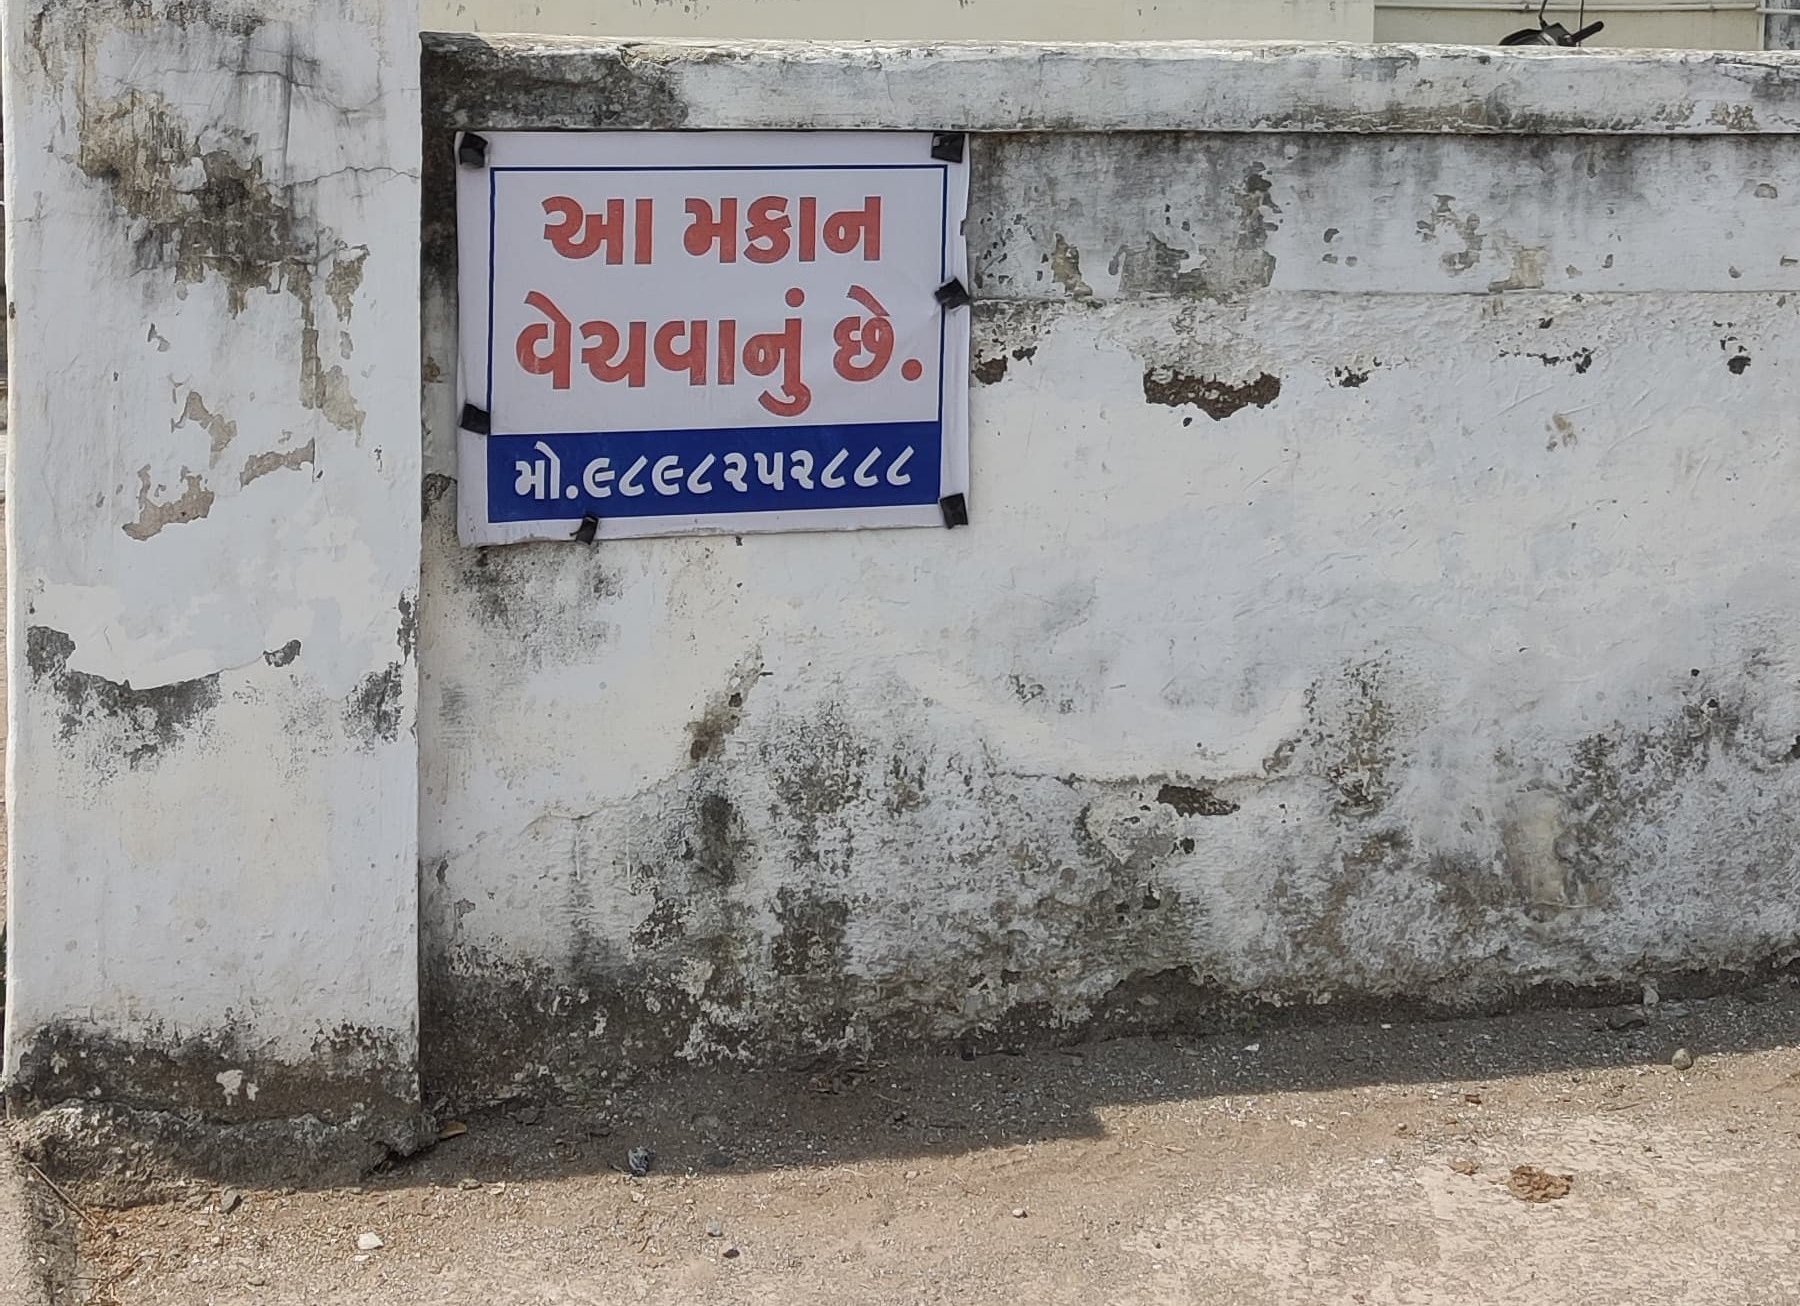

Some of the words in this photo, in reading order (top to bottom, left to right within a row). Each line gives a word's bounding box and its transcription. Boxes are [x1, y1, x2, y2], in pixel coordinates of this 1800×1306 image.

[541, 196, 653, 265] આ
[683, 195, 881, 264] મકાન
[515, 287, 812, 417] વેચવાનું
[832, 285, 922, 382] છે.
